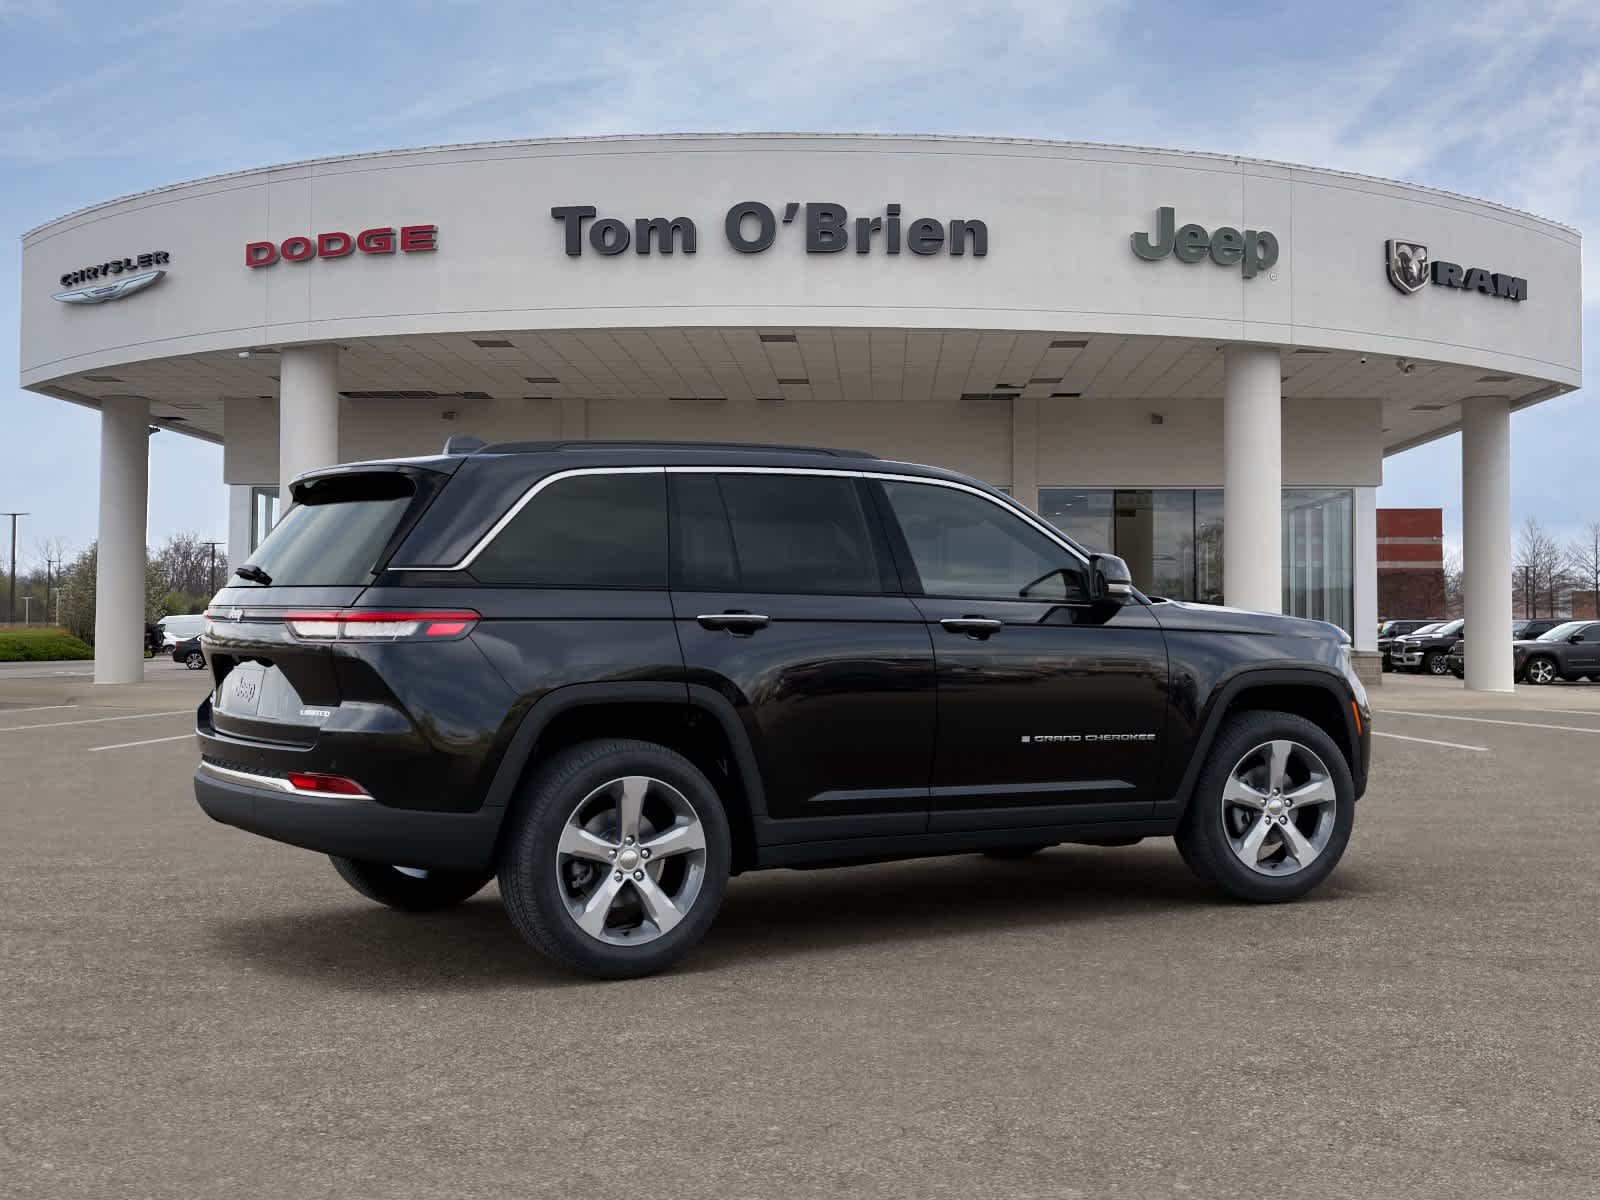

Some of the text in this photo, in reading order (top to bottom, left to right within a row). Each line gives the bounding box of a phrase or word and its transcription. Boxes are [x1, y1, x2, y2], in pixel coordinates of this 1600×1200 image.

[246, 225, 438, 268] DODGE
[551, 201, 989, 257] Tom O'Brien
[1130, 207, 1279, 279] Jeep
[60, 251, 169, 286] CHRYSLER
[1431, 260, 1527, 302] RAM
